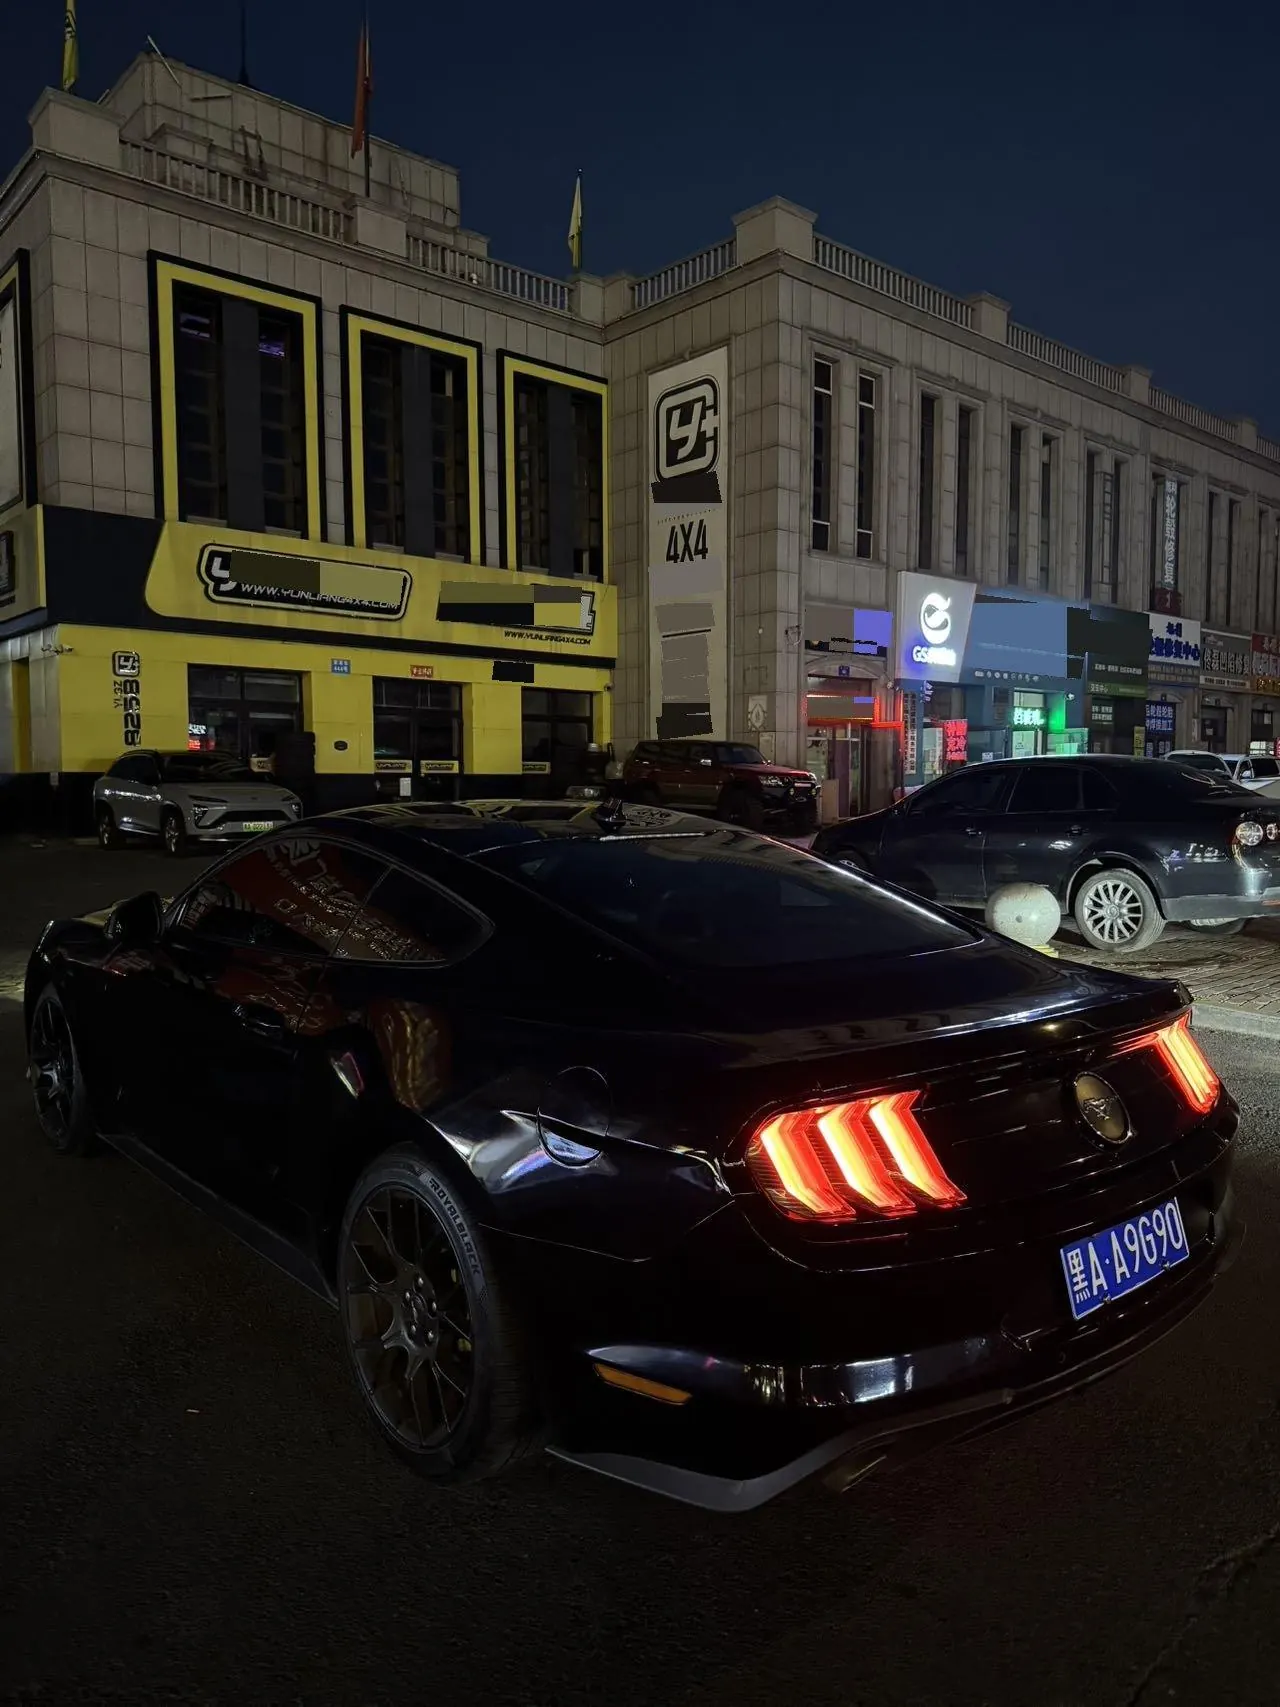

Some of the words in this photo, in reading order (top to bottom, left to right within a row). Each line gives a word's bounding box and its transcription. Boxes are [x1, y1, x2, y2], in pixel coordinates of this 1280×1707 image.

[667, 519, 708, 563] 4X4
[123, 679, 141, 747] 8258
[429, 1178, 480, 1275] ROYALBLACK
